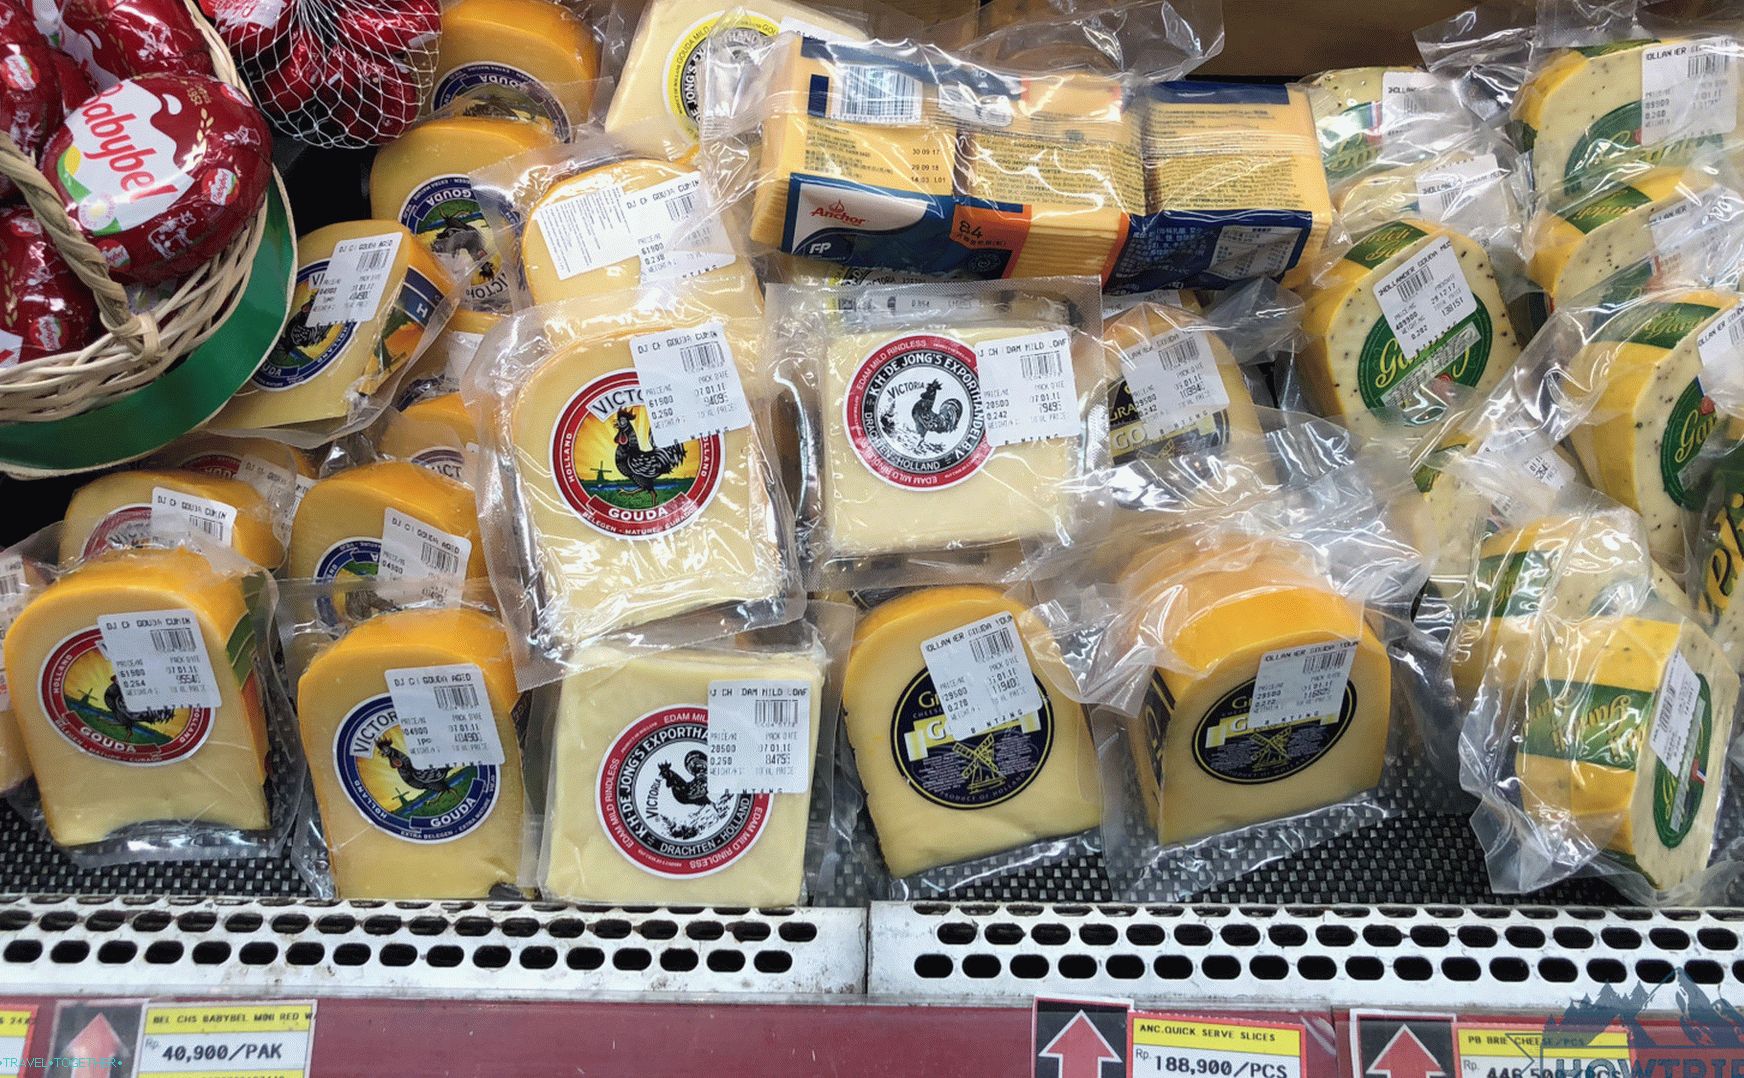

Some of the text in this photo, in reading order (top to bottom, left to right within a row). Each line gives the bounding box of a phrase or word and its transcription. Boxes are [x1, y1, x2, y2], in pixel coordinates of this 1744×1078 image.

[426, 189, 472, 207] GOUDA
[810, 206, 867, 227] Anchor
[1005, 345, 1021, 354] DAM
[1052, 338, 1067, 347] OAF
[902, 353, 943, 367] JONG'S
[857, 370, 871, 391] EDAM
[887, 381, 925, 400] VICTORIA
[564, 432, 574, 483] HOLLAND
[701, 435, 711, 477] OLLAND
[898, 457, 941, 471] HOLLAND
[608, 507, 669, 522] GOUDA
[52, 653, 73, 695] HOLLAND
[741, 688, 758, 697] DAM
[792, 688, 807, 697] OAF
[663, 712, 708, 724] EDAM MIL
[80, 726, 137, 753] GOUDA
[620, 750, 646, 793] JONG'S
[354, 779, 388, 820] HOLLAND
[604, 758, 620, 802] RINDLESS
[616, 826, 634, 849] EDAM
[646, 778, 664, 819] VICTORIA
[430, 796, 476, 828] GOUDA
[749, 806, 763, 833] EDAM
[659, 797, 751, 857] DRACHTEN HOLLAND
[279, 1010, 300, 1022] RED
[1139, 1024, 1276, 1042] ANC.QUICK SERVE SLICES
[1468, 1035, 1482, 1044] PB
[1486, 1036, 1508, 1045] BRIE
[162, 1042, 283, 1062] 40,900/PAK
[1135, 1048, 1288, 1078] Rp. 188,900/PCS
